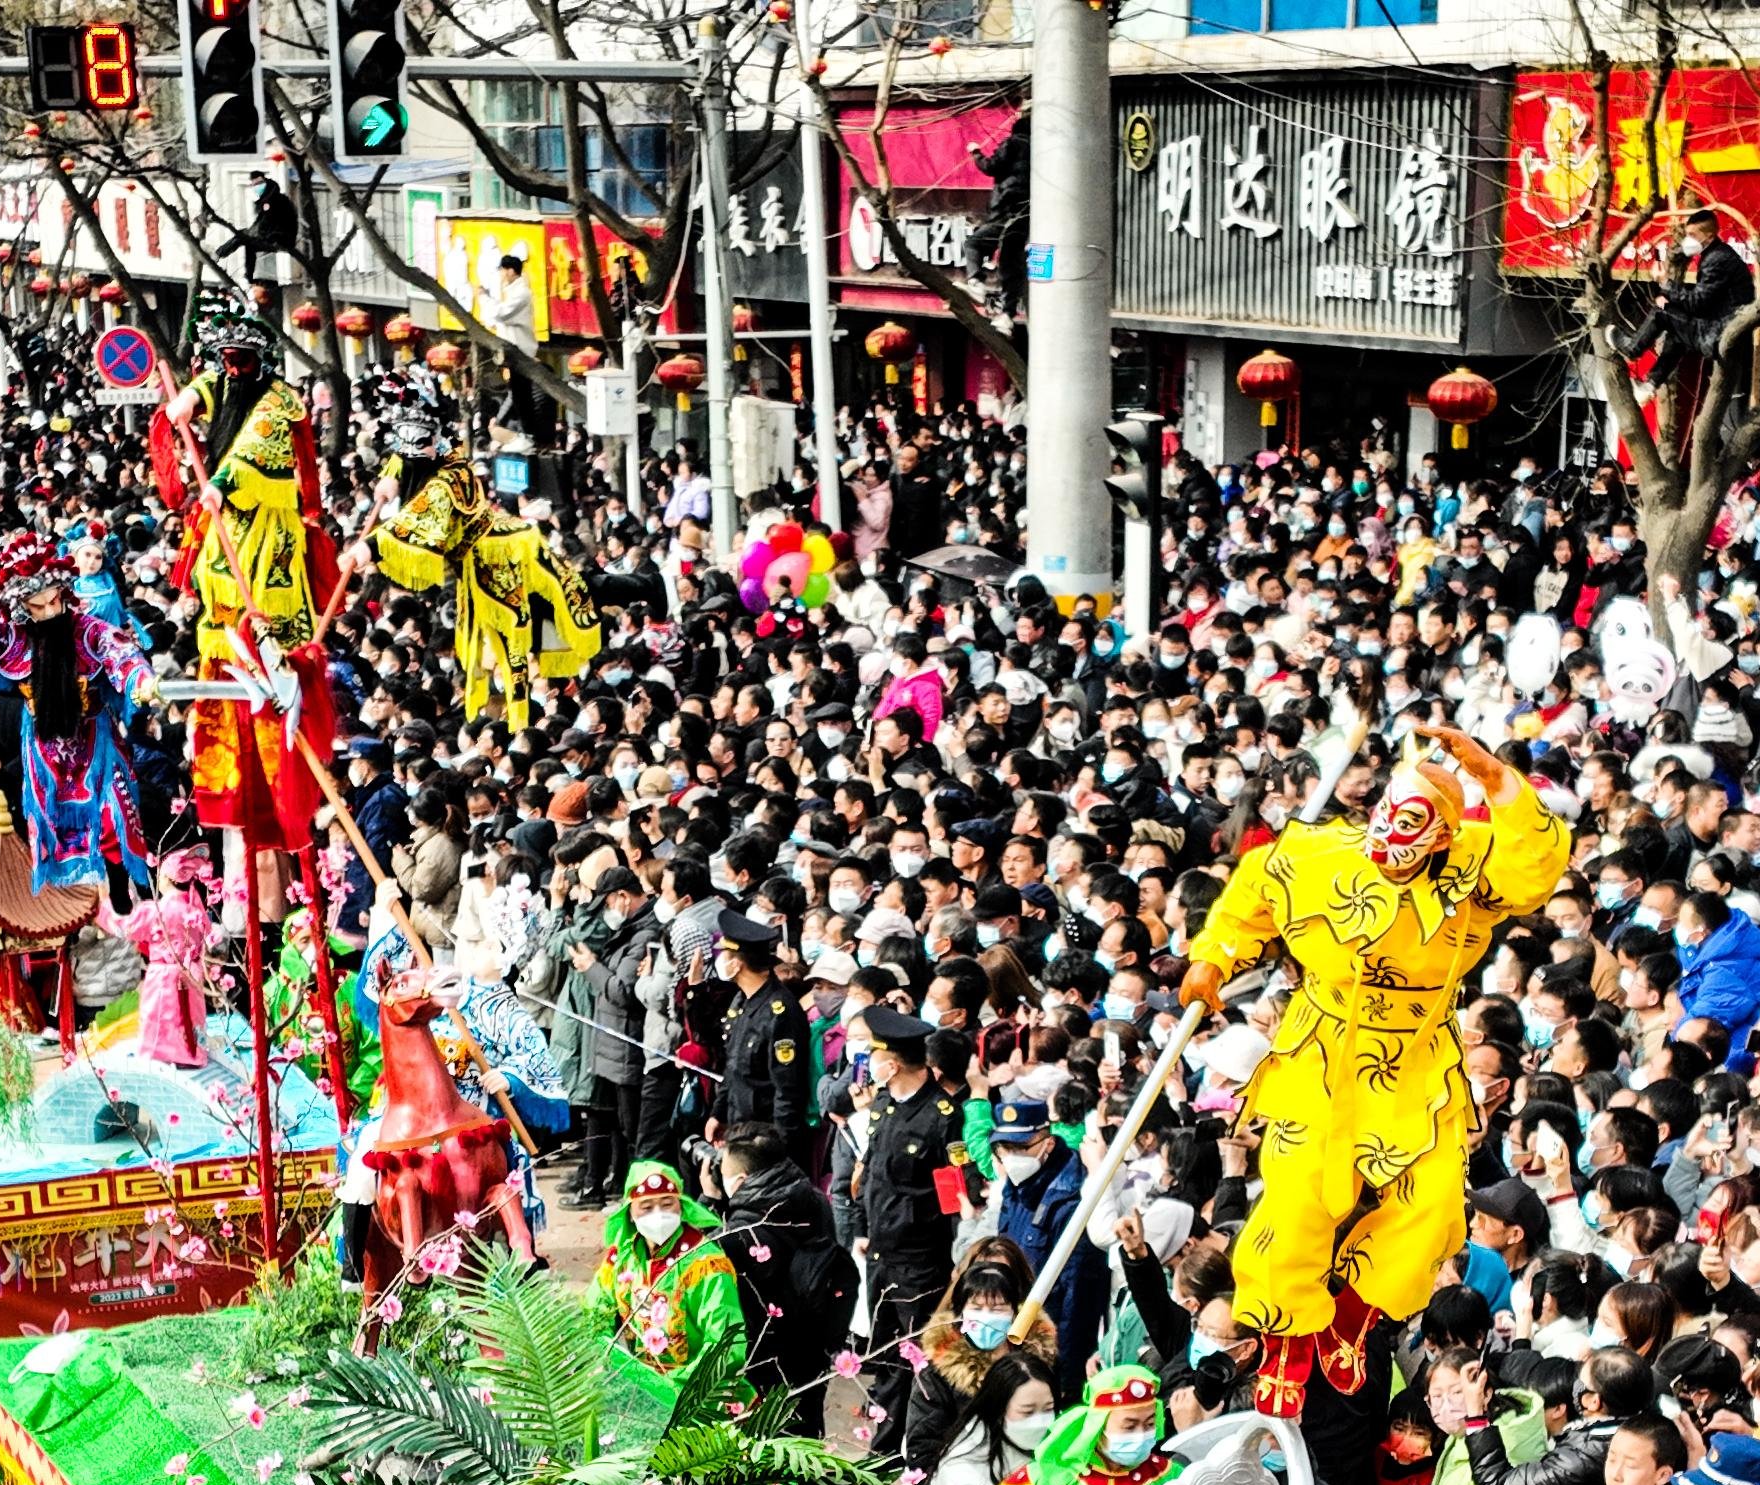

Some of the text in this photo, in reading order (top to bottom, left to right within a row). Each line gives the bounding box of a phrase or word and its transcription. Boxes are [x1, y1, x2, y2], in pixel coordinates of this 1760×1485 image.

[84, 24, 132, 107] 8
[1157, 125, 1454, 257] 明达眼镜
